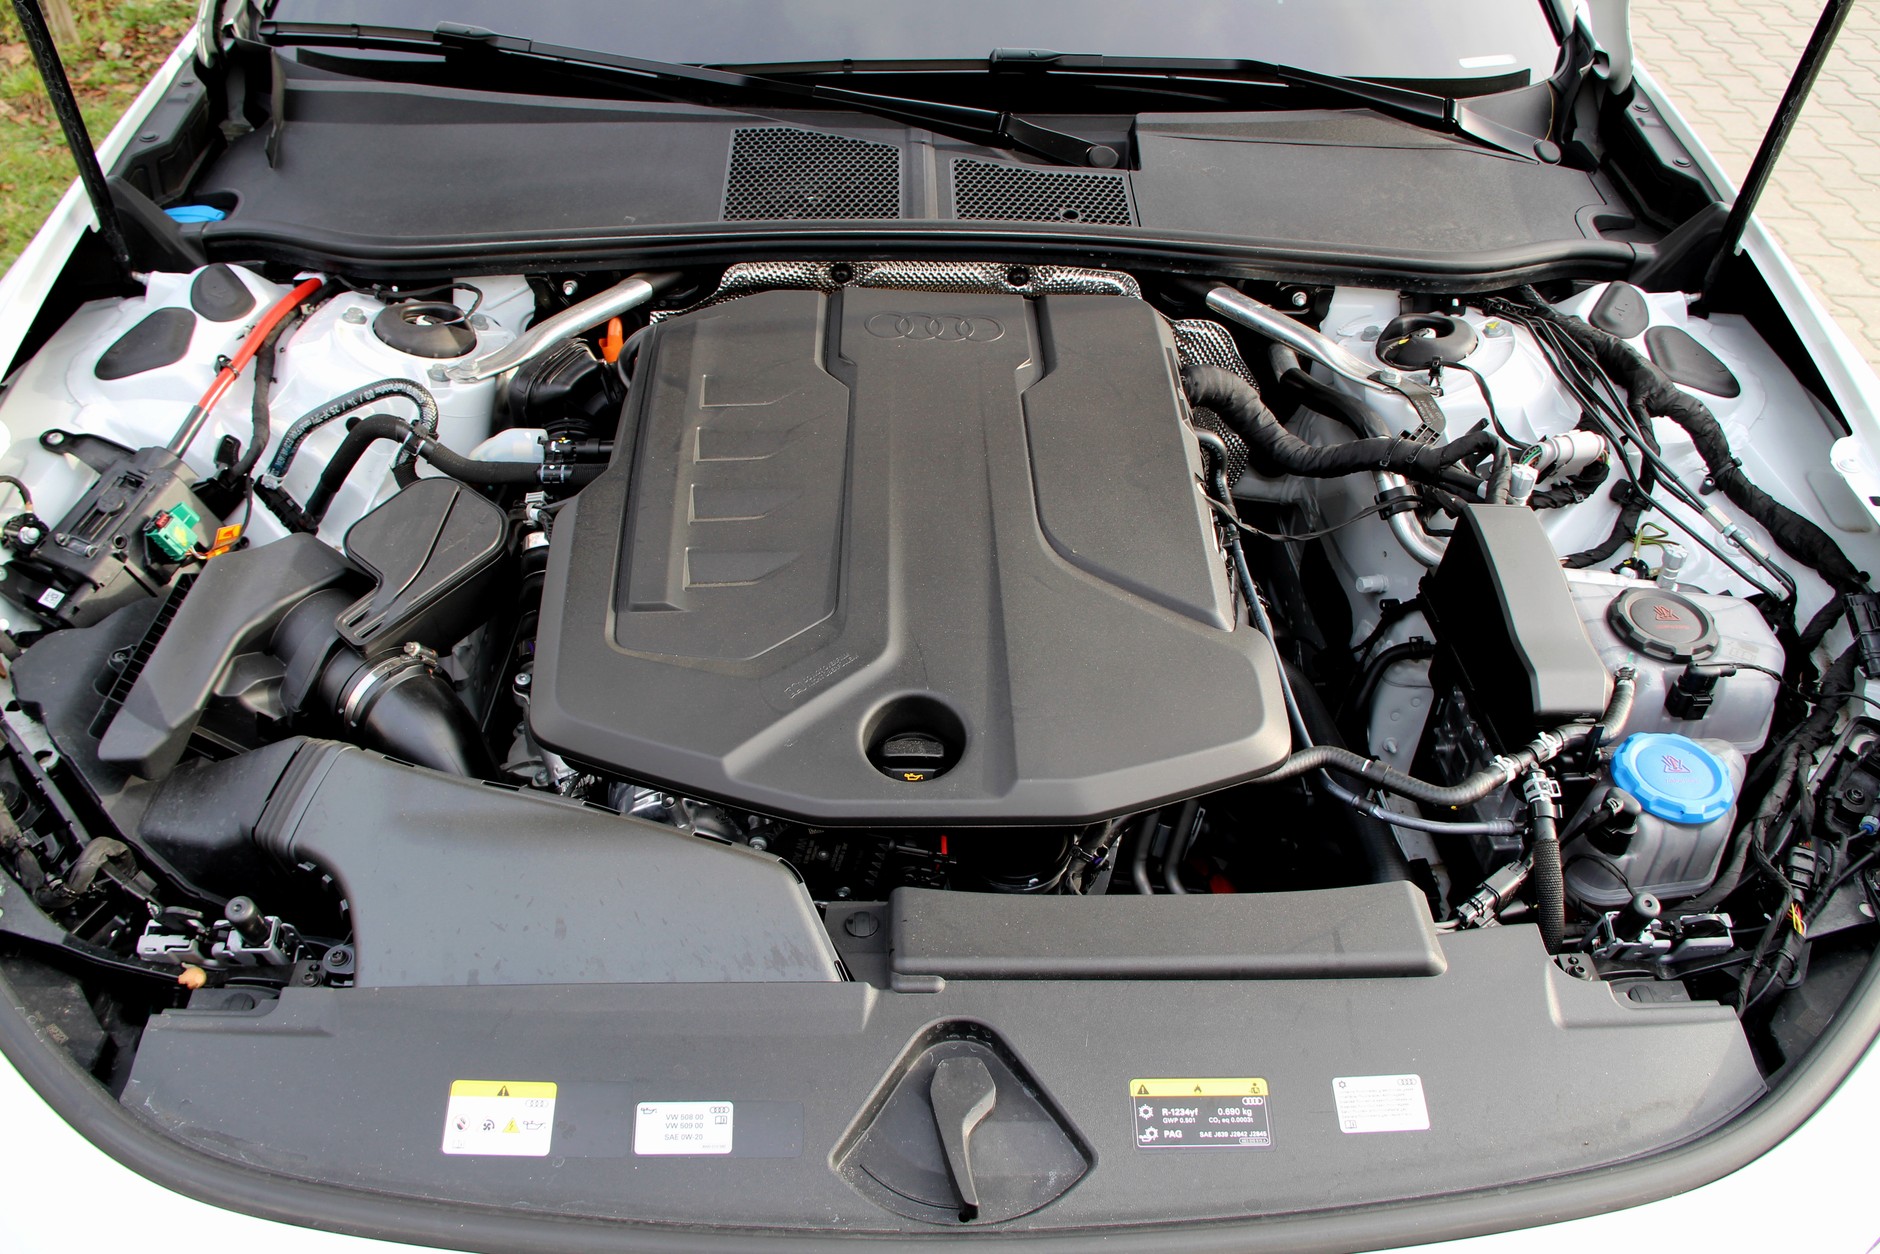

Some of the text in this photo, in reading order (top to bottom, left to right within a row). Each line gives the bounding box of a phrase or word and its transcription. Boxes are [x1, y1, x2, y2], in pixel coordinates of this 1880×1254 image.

[1162, 1108, 1198, 1117] R-1234yf
[1217, 1108, 1252, 1117] 0.690 kg
[1221, 1117, 1230, 1125] eq
[1164, 1130, 1183, 1138] PAG
